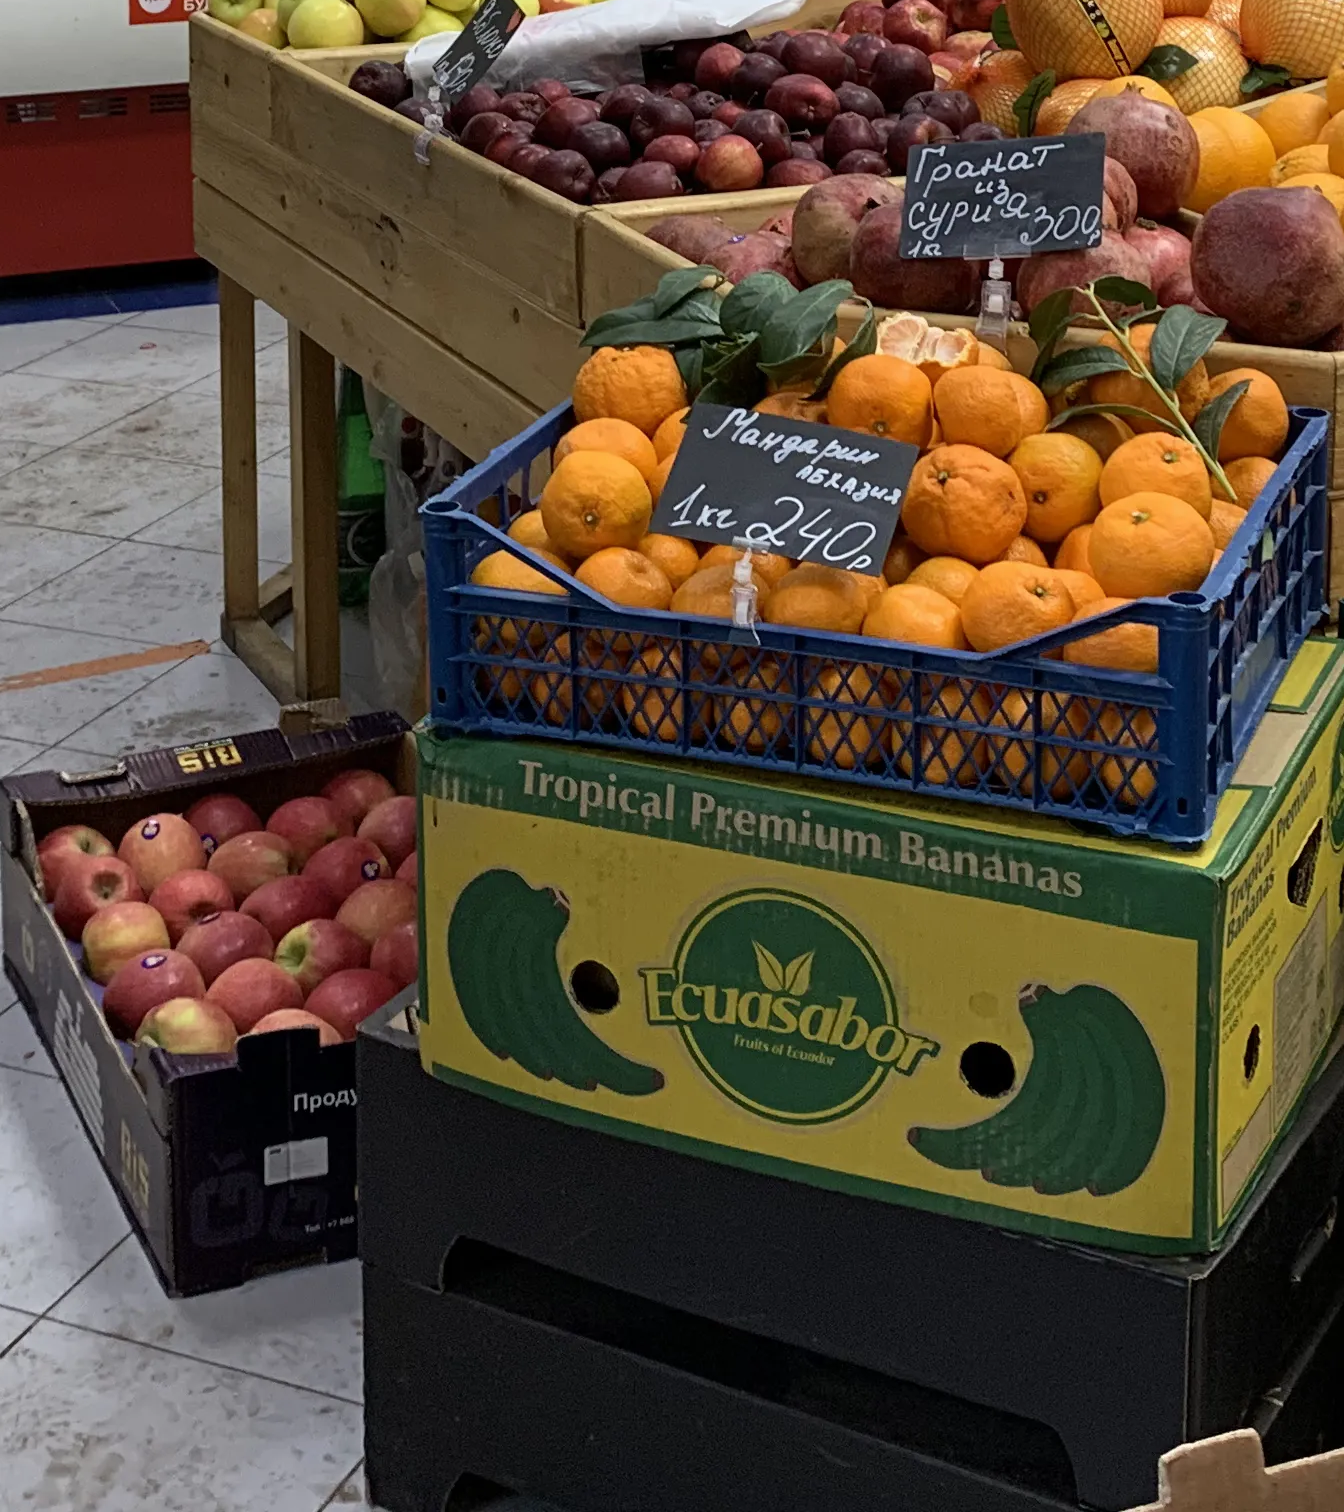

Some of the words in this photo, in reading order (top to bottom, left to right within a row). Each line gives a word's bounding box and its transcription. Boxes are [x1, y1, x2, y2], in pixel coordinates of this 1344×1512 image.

[914, 143, 1065, 198] Гранат
[974, 179, 1010, 204] из
[702, 407, 880, 464] Мандарин
[517, 760, 676, 821] Tropical
[690, 791, 883, 861] Premium
[898, 831, 1084, 899] Bananas
[1230, 829, 1275, 915] Tropical
[1276, 765, 1317, 848] Premium
[1226, 867, 1275, 949] Bananas
[638, 967, 941, 1076] Ecuasabor
[733, 1033, 769, 1053] Fruits
[771, 1042, 784, 1056] of
[785, 1044, 836, 1067] Ecuador
[293, 1088, 357, 1114] Проду
